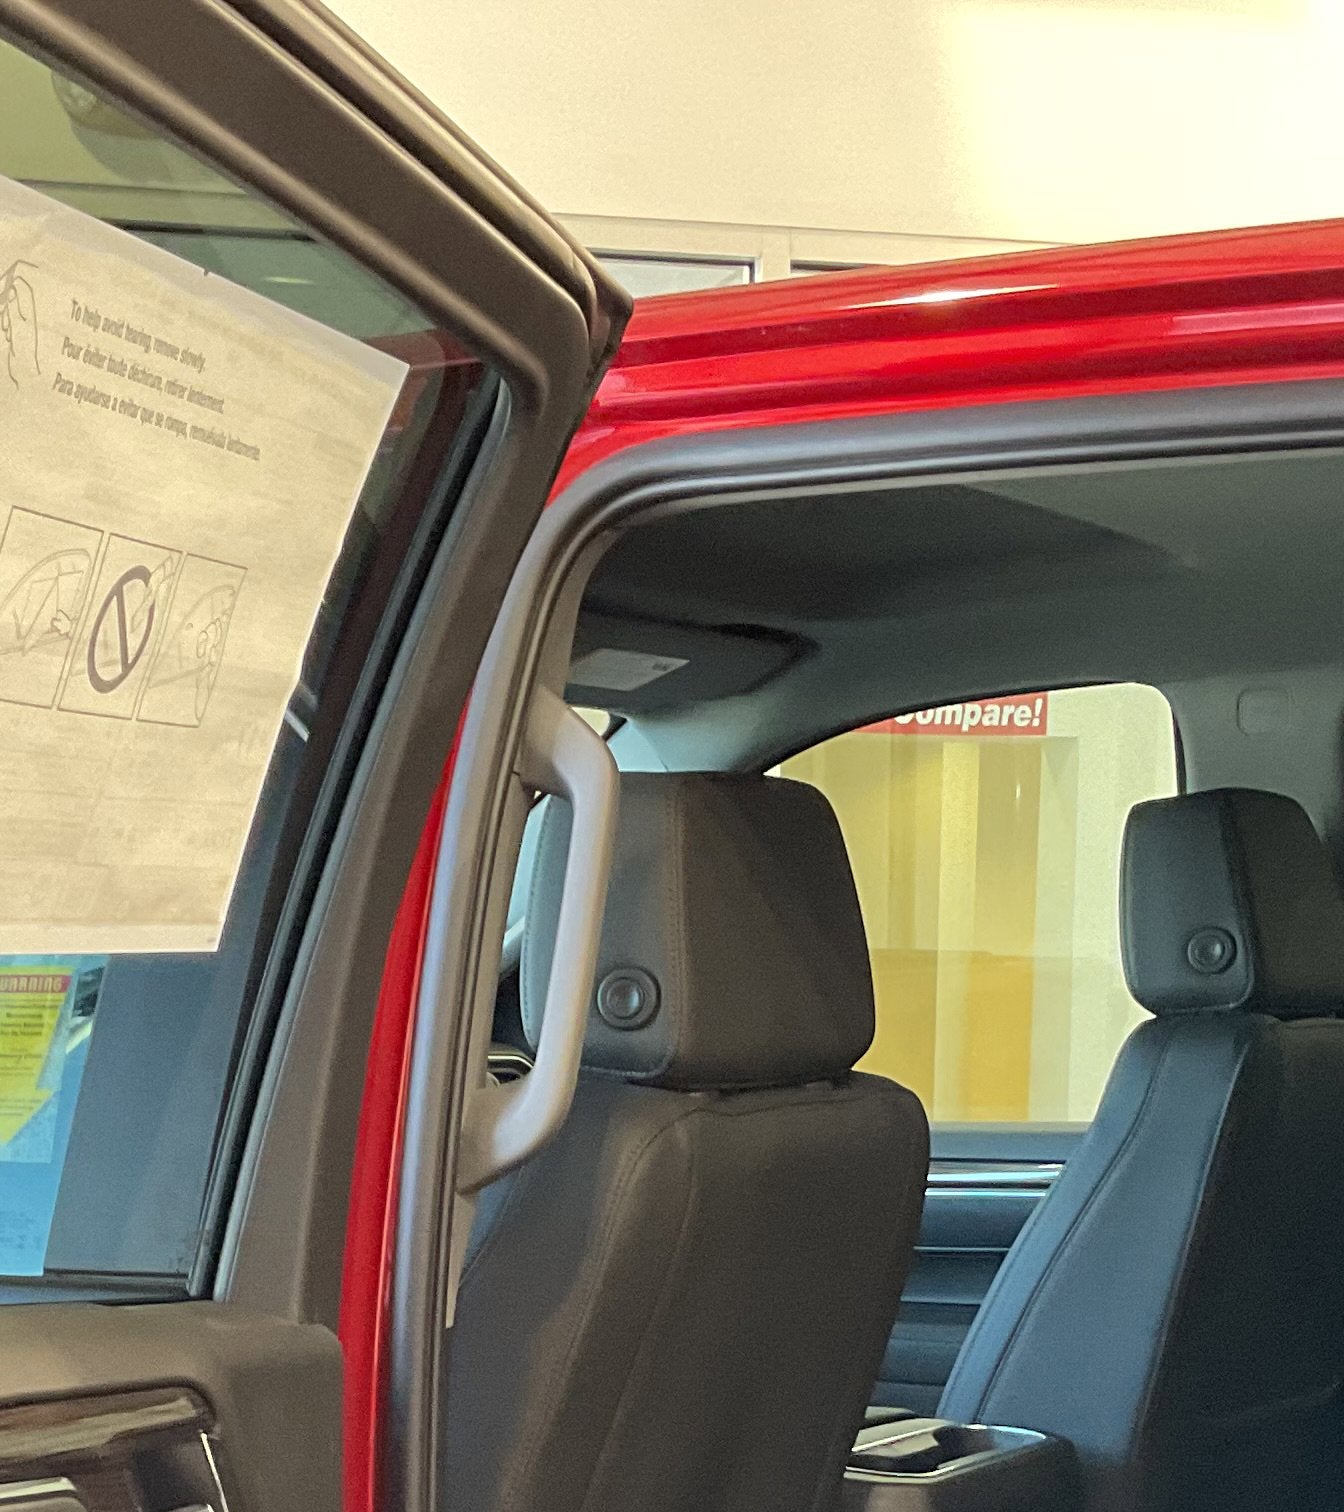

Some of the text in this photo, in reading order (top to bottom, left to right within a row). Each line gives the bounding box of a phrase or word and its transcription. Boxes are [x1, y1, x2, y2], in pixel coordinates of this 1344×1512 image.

[71, 299, 82, 322] To
[83, 306, 101, 332] help
[102, 317, 125, 338] avoid
[61, 336, 83, 360] Pour
[82, 344, 107, 369] éviter
[52, 372, 74, 396] Para
[111, 396, 118, 412] a
[118, 398, 142, 419] evitar
[140, 407, 155, 426] que
[154, 411, 164, 429] se
